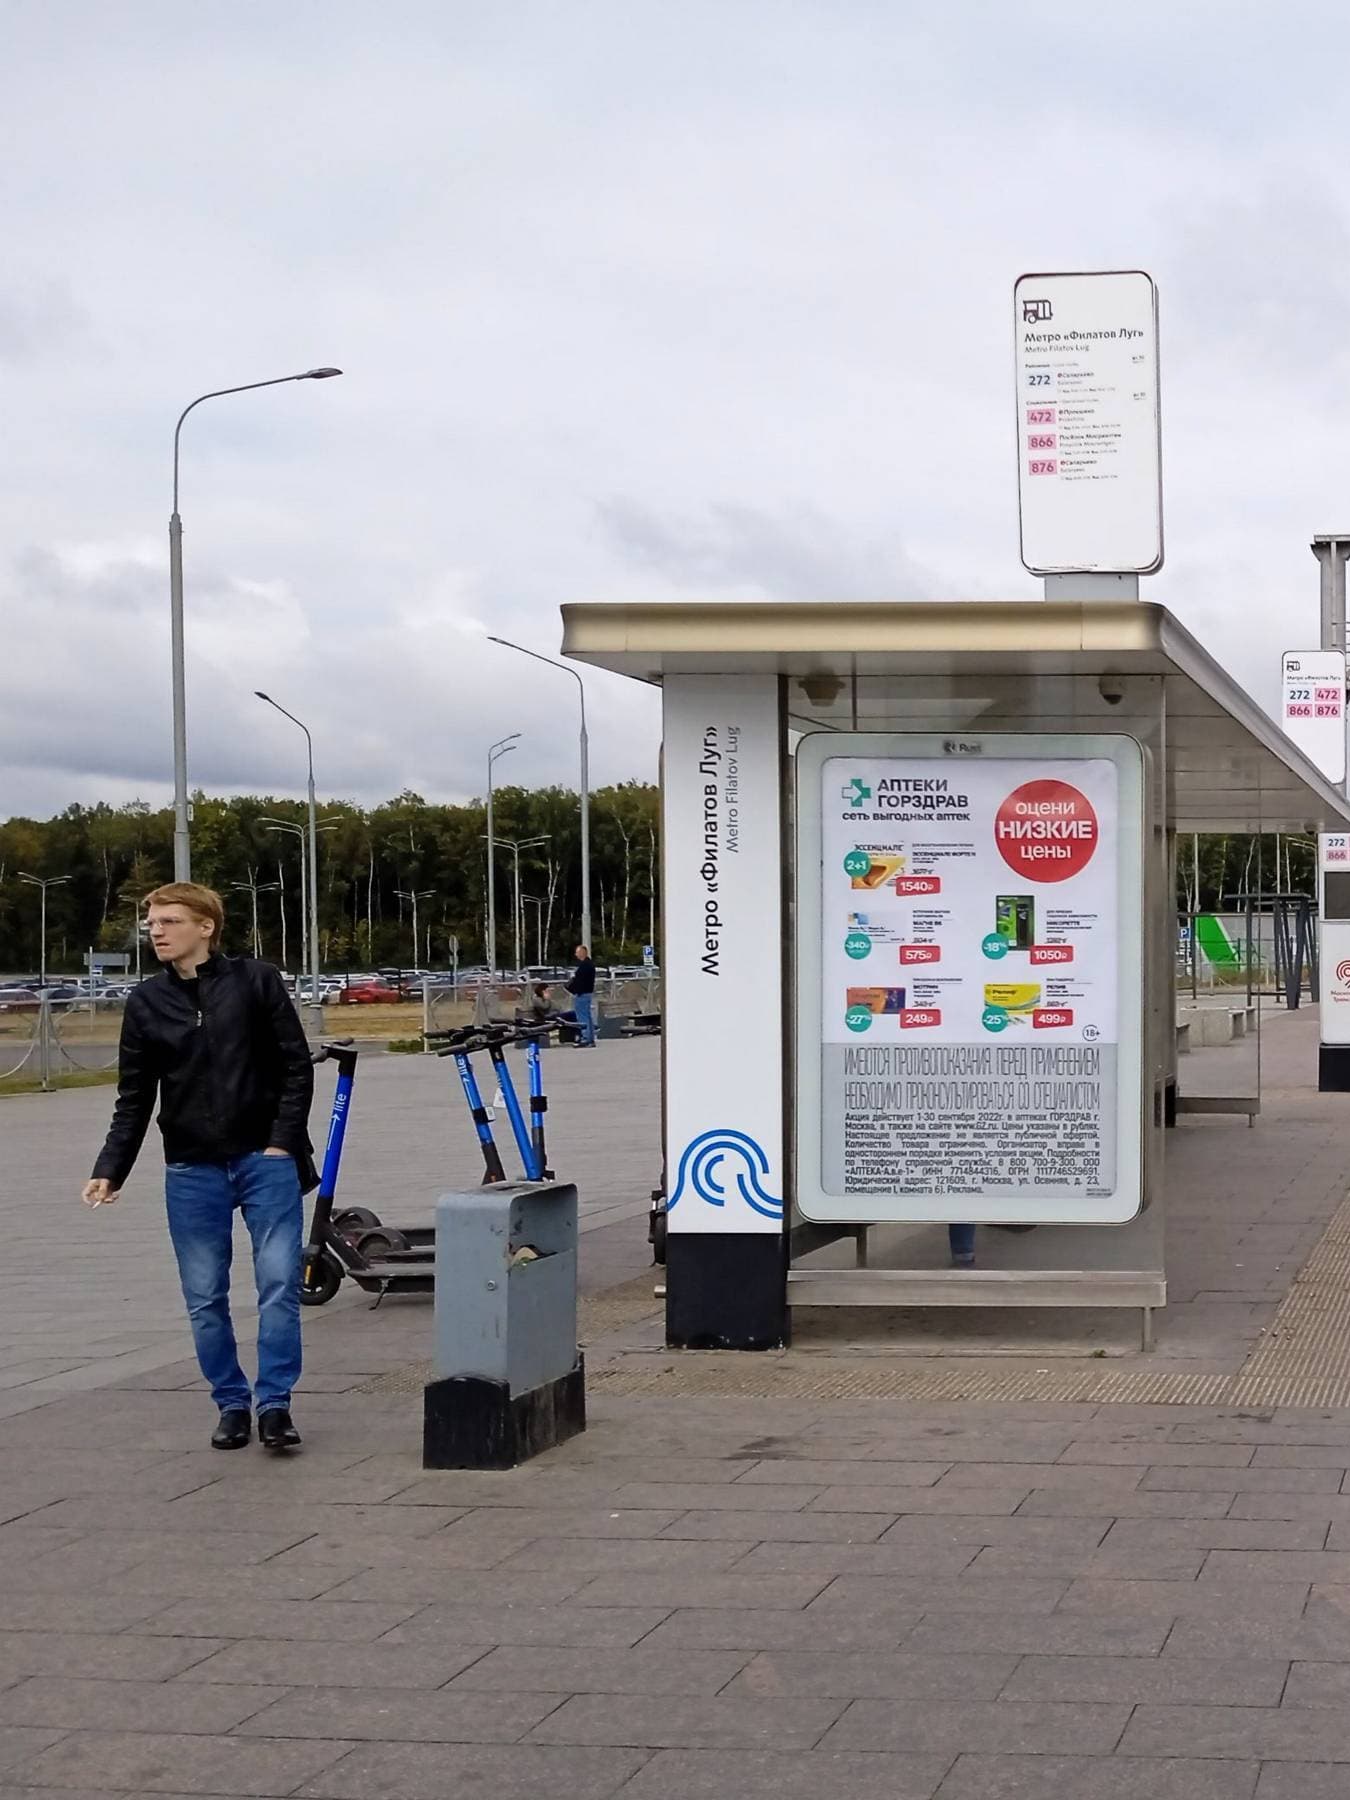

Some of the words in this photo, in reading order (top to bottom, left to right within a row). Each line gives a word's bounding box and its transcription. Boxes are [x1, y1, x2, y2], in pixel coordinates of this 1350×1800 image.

[1024, 333, 1061, 343] Метро
[1063, 330, 1116, 340] «Филатов
[1119, 328, 1144, 339] Луг»
[1028, 375, 1051, 386] 272
[1030, 412, 1052, 422] 472
[1031, 437, 1053, 448] 866
[1031, 462, 1054, 473] 876
[1290, 690, 1310, 700] 272
[1318, 690, 1338, 700] 472
[1290, 706, 1310, 716] 866
[1317, 706, 1338, 716] 876
[725, 726, 741, 753] Lug
[700, 726, 722, 777] Луг»
[725, 757, 738, 804] Filatov
[877, 779, 948, 792] АПТЕКИ
[878, 795, 968, 810] ГОРЗДРАВ
[1016, 802, 1075, 817] оцени
[842, 812, 870, 821] сеть
[873, 812, 934, 822] выгодных
[936, 813, 971, 821] аптек
[726, 808, 739, 853] Metro
[999, 820, 1092, 839] НИЗКИЕ
[700, 784, 719, 893] «Филатов
[1328, 839, 1345, 847] 272
[1021, 845, 1071, 860] цены
[1328, 851, 1345, 860] 866
[847, 860, 867, 871] 2+1
[701, 899, 723, 976] Метро
[1180, 928, 1188, 938] P
[997, 1048, 1027, 1079] ПЕРЕД
[1031, 1048, 1100, 1075] ПРИМЕНЕНИЕМ
[1018, 1082, 1029, 1110] СО
[334, 1093, 347, 1112] lite
[845, 1113, 869, 1121] Акция
[872, 1113, 913, 1122] действует
[938, 1112, 975, 1122] сентября
[1050, 1112, 1091, 1122] ГОРЗДРАВ
[928, 1122, 952, 1130] сайте
[1002, 1122, 1023, 1131] Цены
[1026, 1123, 1060, 1132] указаны
[845, 1131, 890, 1139] Настоящее
[896, 1132, 951, 1140] предложение
[1015, 1131, 1057, 1141] публичной
[845, 1140, 892, 1148] Количество
[997, 1140, 1048, 1150] Организатор
[845, 1150, 907, 1158] одностороннем
[909, 1150, 943, 1158] порядке
[985, 1150, 1017, 1159] условия
[1047, 1149, 1100, 1158] Подробности
[861, 1159, 900, 1168] телефону
[905, 1158, 953, 1168] справочной
[1008, 1167, 1029, 1175] ОГРН
[845, 1176, 900, 1185] Юридический
